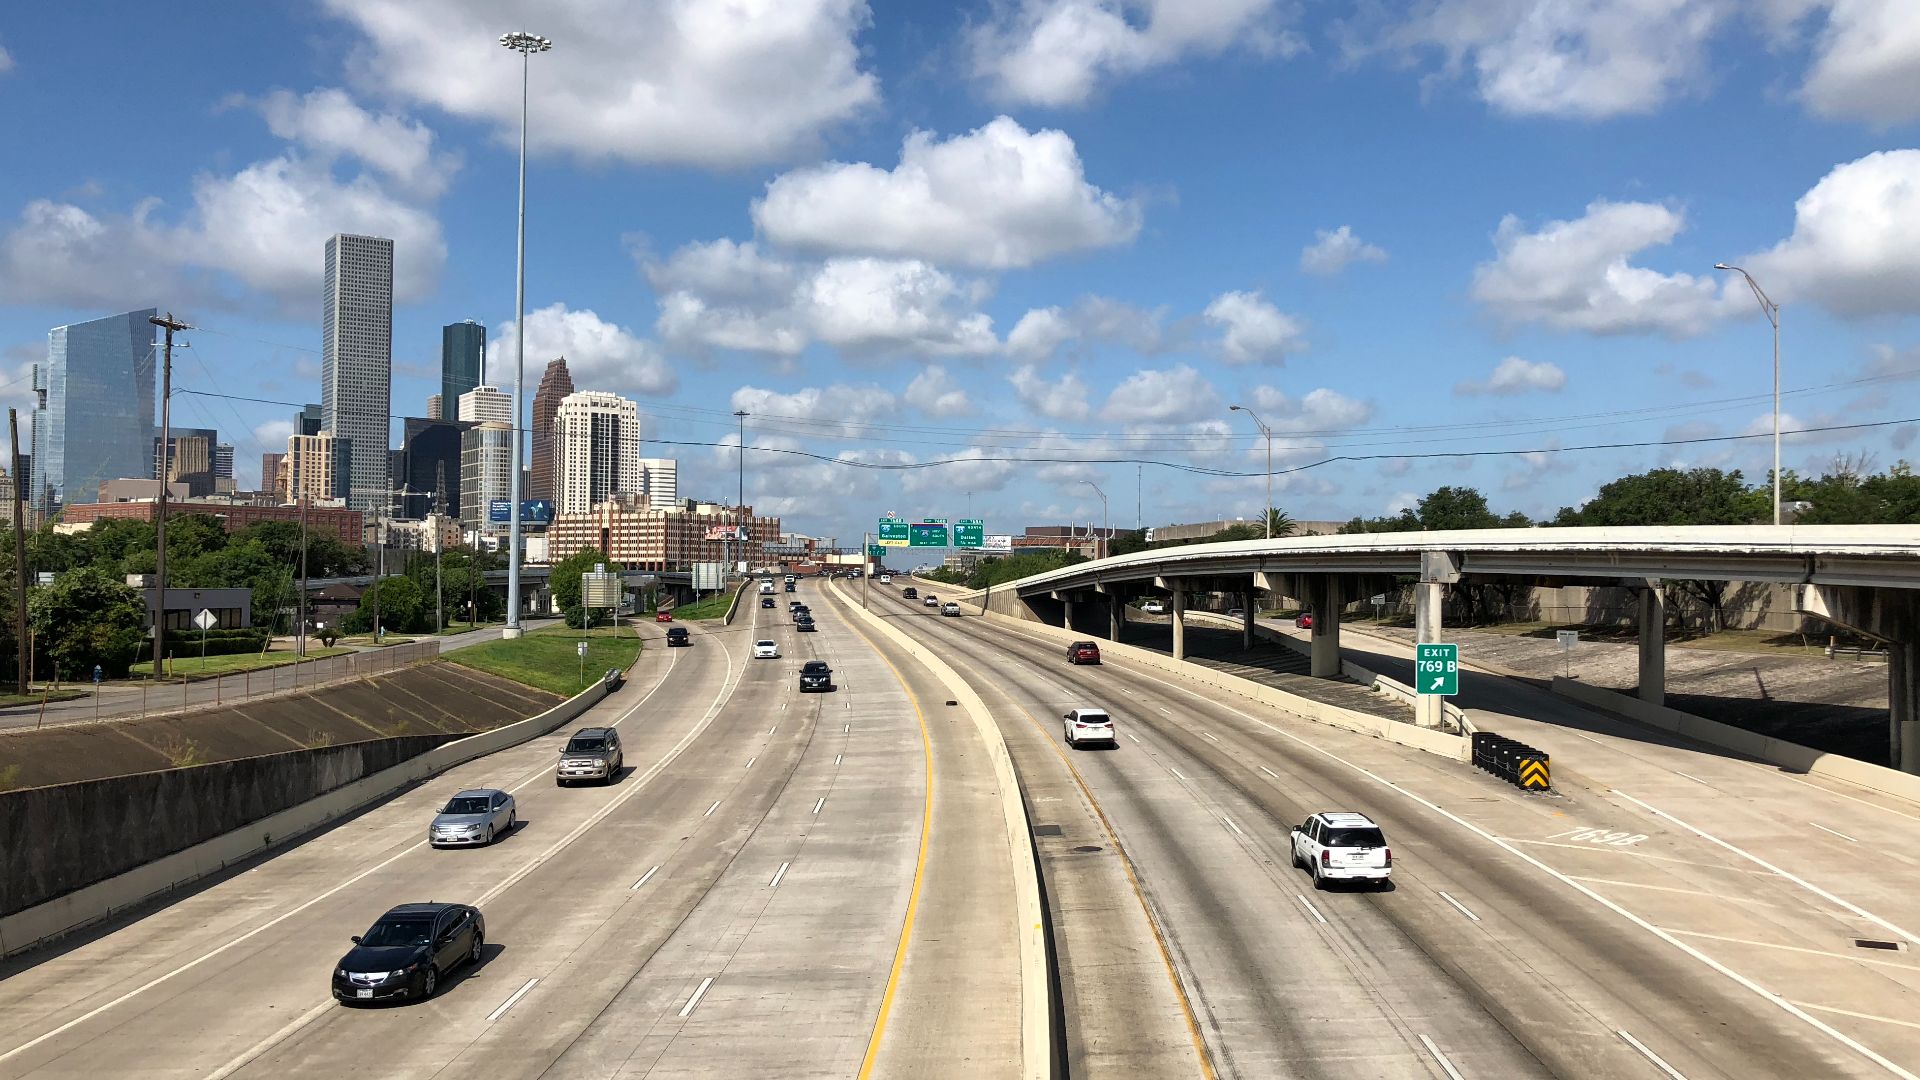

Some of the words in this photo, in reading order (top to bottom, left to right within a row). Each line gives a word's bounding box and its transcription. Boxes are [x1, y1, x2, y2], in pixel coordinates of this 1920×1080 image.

[1424, 648, 1450, 656] EXIT
[1418, 660, 1443, 672] 769
[1447, 660, 1456, 672] B
